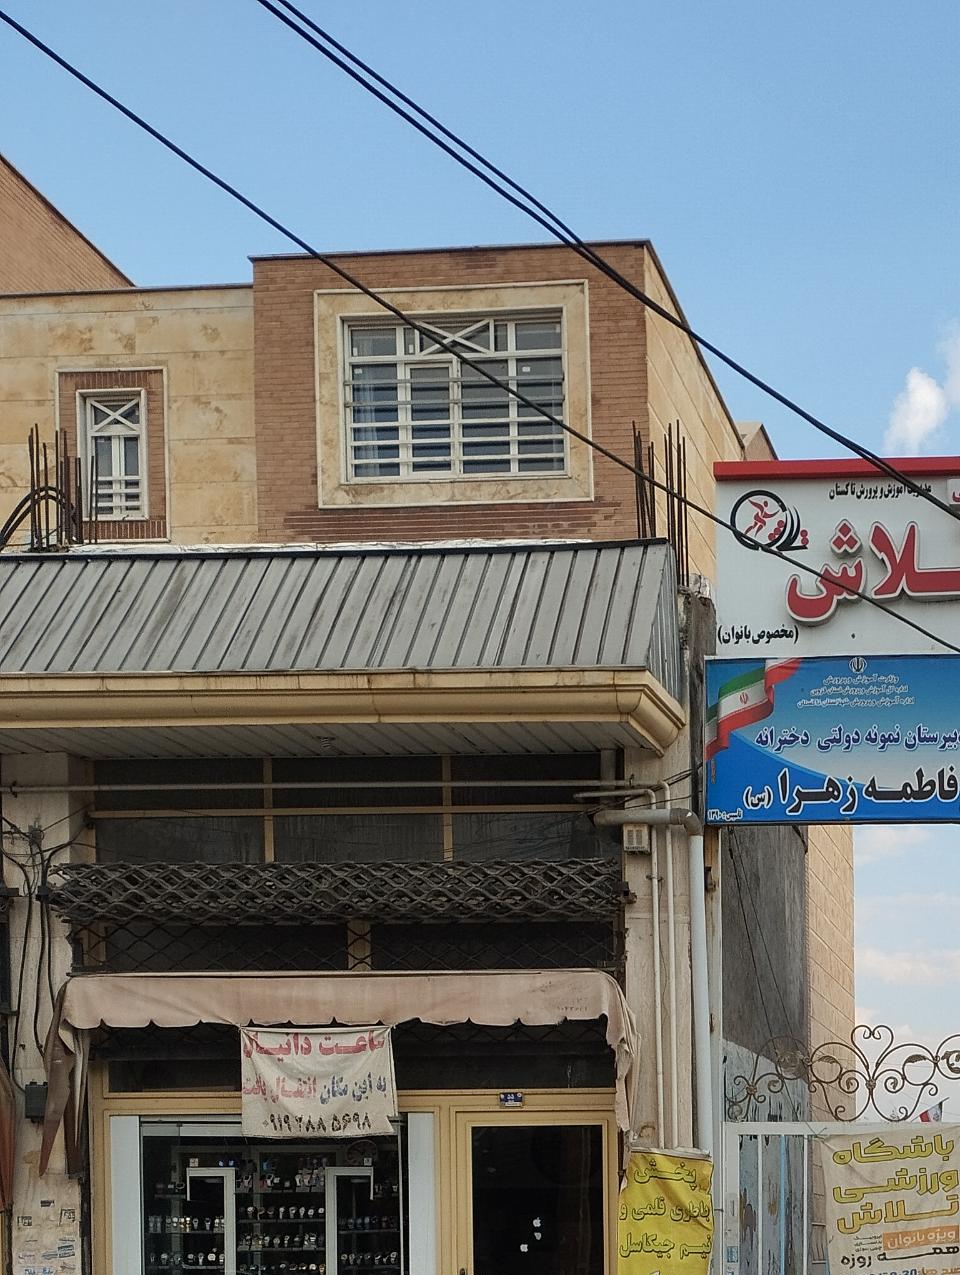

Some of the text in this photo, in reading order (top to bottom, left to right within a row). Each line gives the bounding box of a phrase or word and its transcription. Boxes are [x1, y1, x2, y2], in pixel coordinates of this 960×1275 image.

[828, 483, 855, 500] تاکستان
[856, 485, 878, 500] پرورش
[717, 624, 800, 646] (مخصوص بانوان)
[853, 673, 878, 684] آموزش
[755, 726, 810, 752] دخترانه
[817, 724, 861, 751] دولتی
[864, 724, 901, 750] نمونه
[743, 765, 960, 815] فاطمه زهرا (س)
[243, 1030, 385, 1063] ساعت دانیال
[319, 1075, 348, 1105] مکان
[352, 1071, 373, 1102] این
[832, 1134, 955, 1165] باشگاه
[634, 1159, 698, 1191] پخش
[832, 1167, 960, 1204] ورزشی
[618, 1195, 711, 1223] باطری قلمی و
[836, 1194, 960, 1235] تلاش
[619, 1231, 676, 1259] جیکاسل
[679, 1233, 713, 1260] نیم
[887, 1231, 925, 1249] بانوان
[840, 1245, 960, 1270] همه روزه
